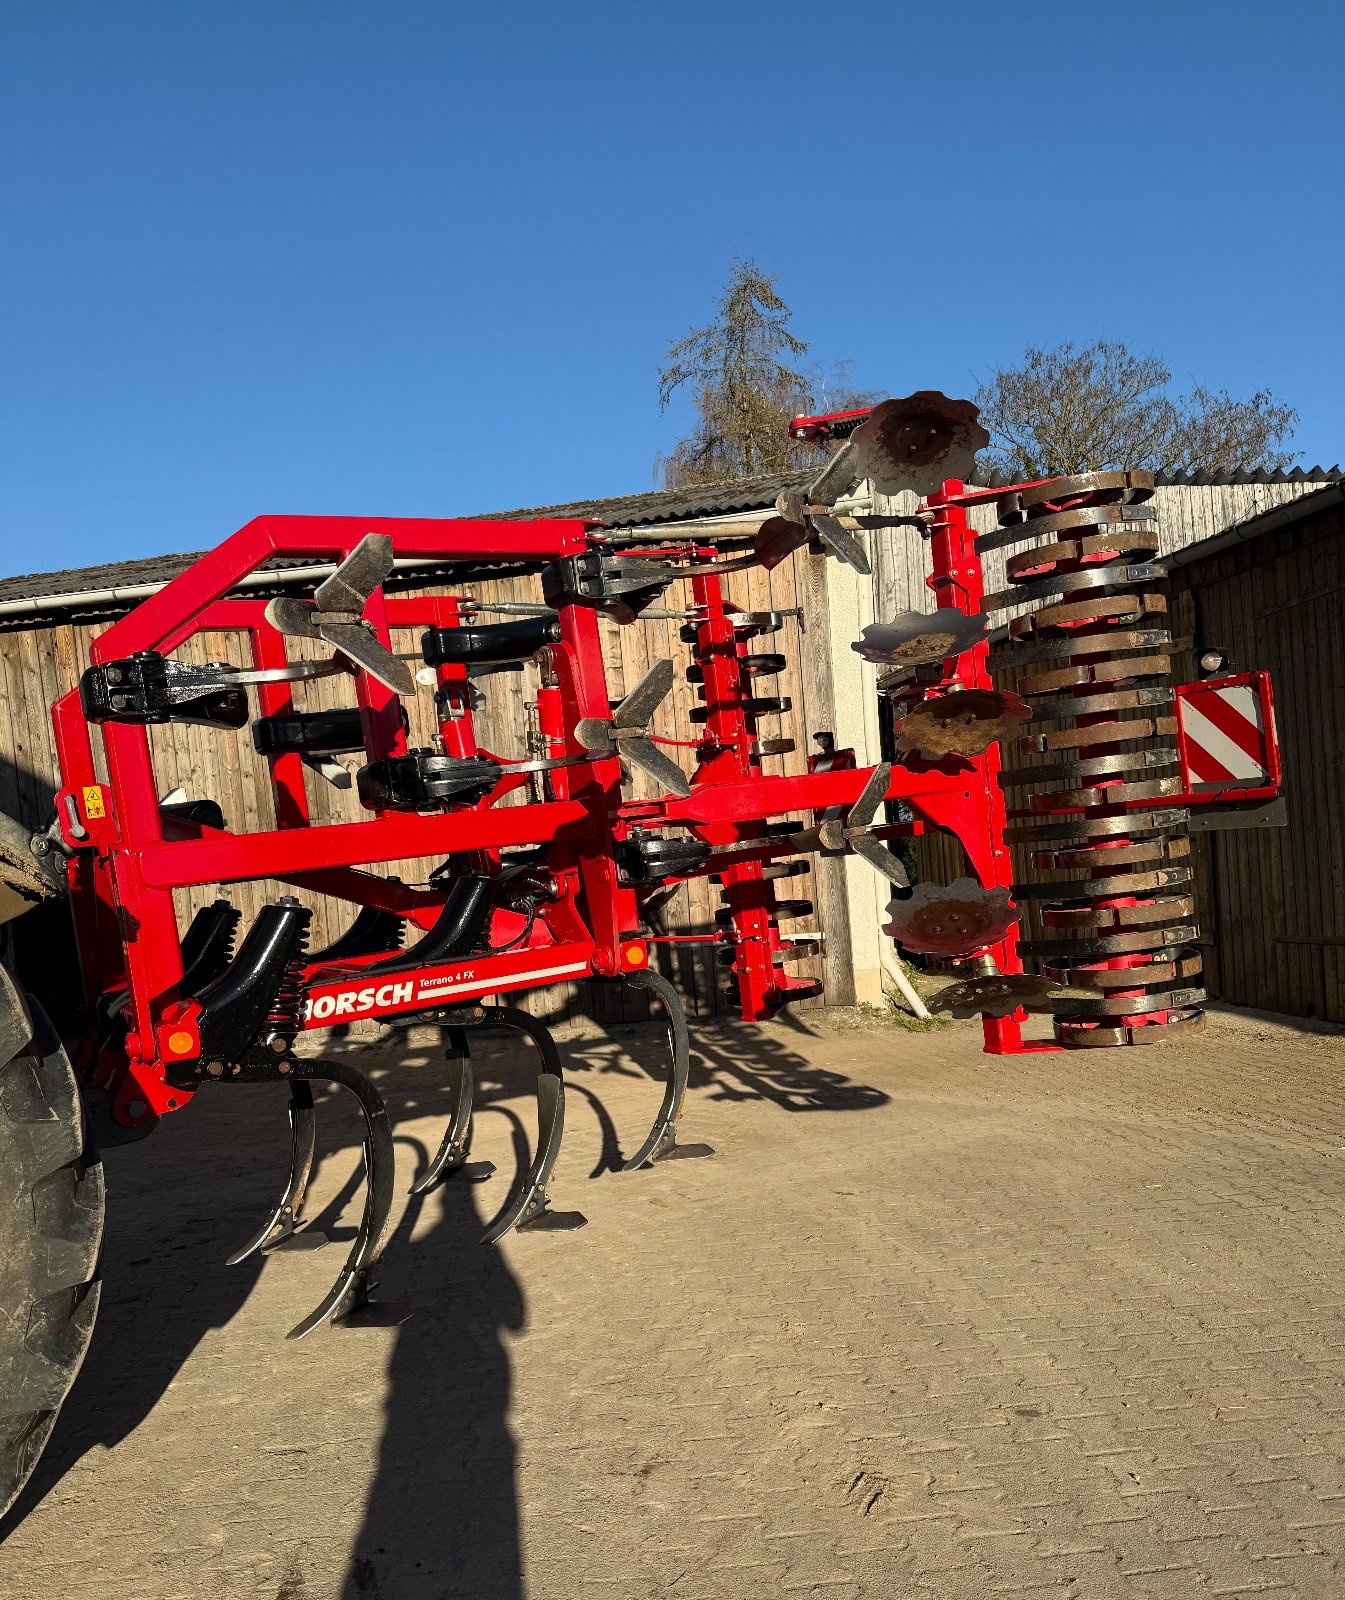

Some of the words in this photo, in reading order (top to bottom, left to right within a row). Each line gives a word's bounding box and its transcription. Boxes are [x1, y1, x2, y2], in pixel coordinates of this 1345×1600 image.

[420, 976, 453, 987] Terrano
[455, 972, 461, 981] 4
[463, 970, 474, 979] FX
